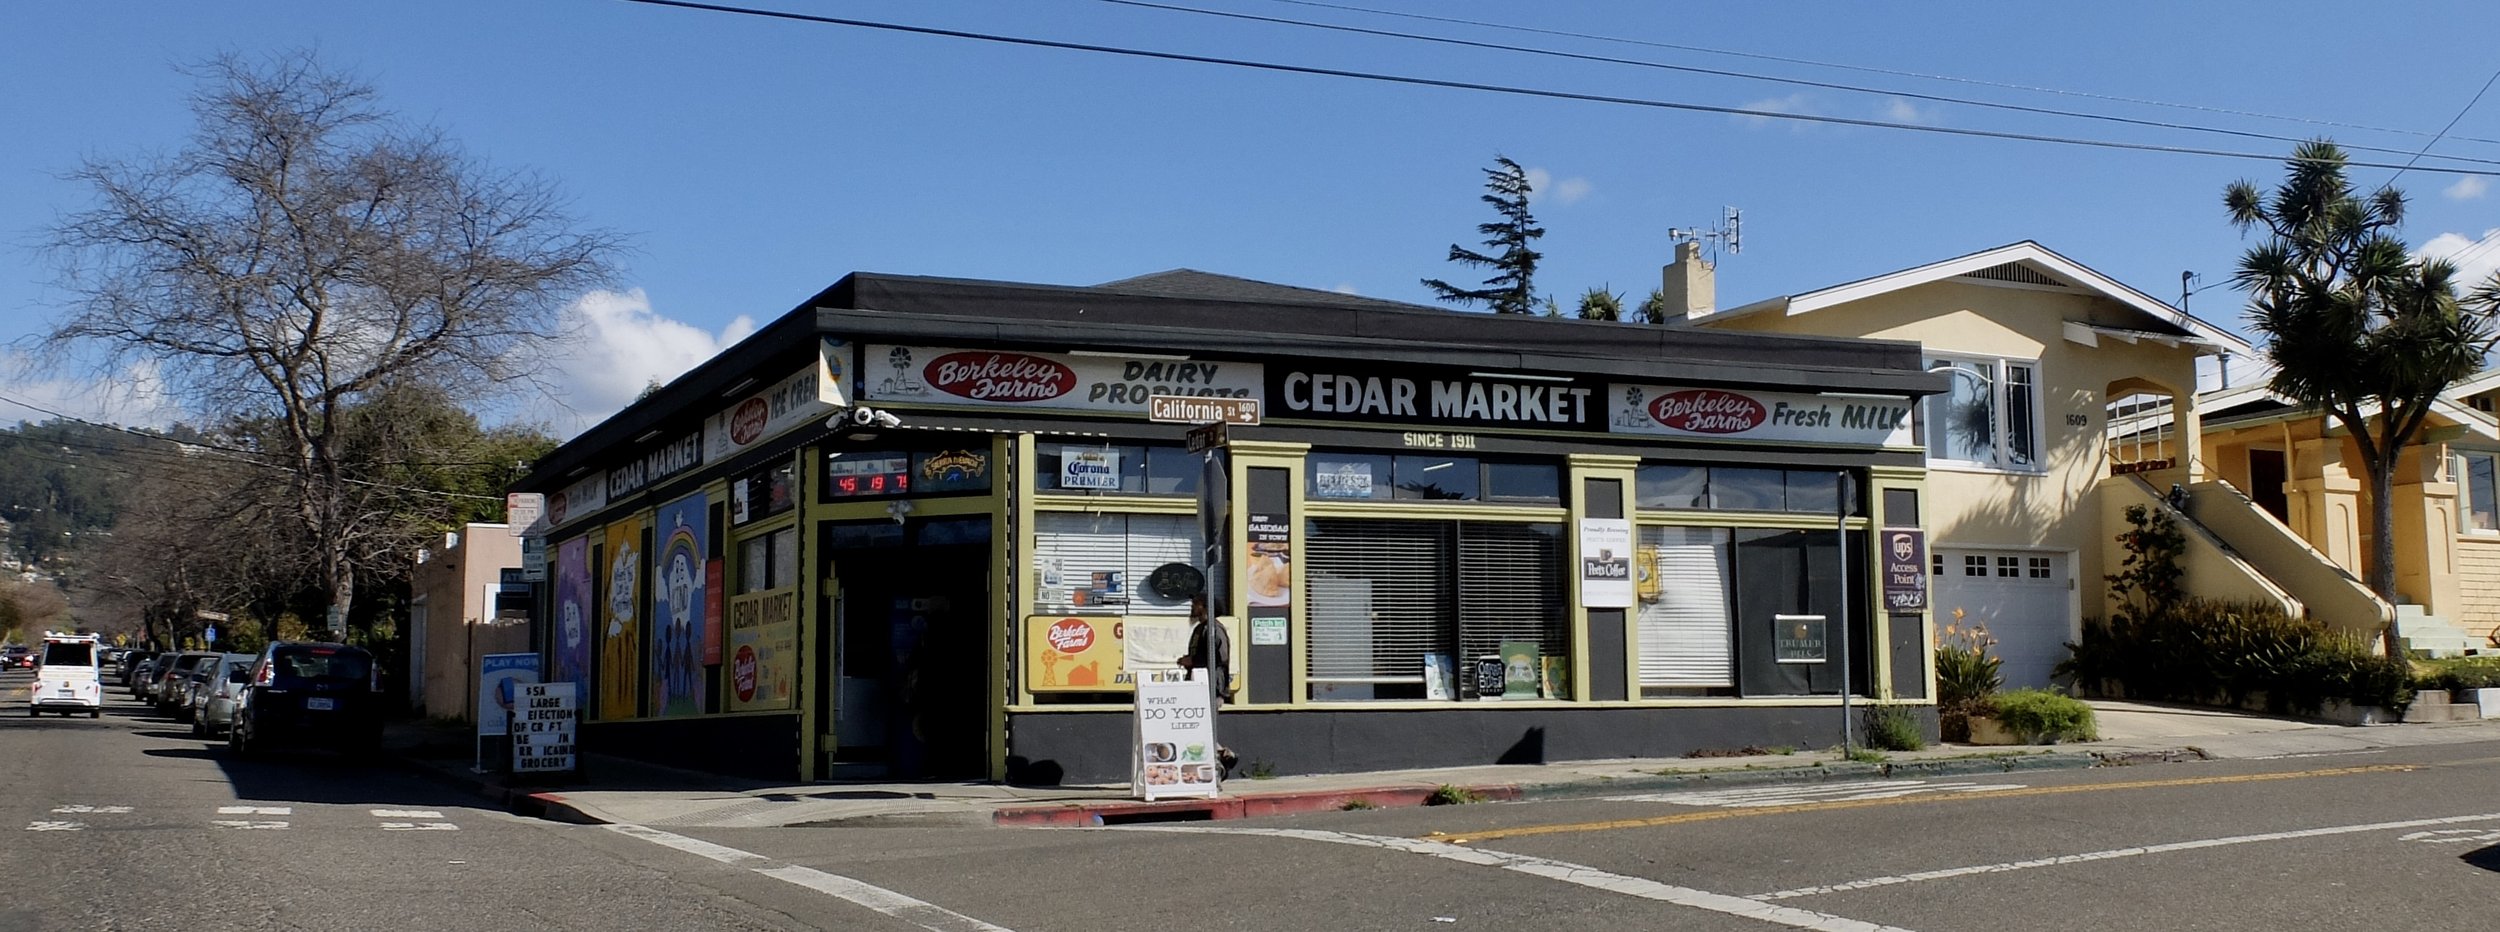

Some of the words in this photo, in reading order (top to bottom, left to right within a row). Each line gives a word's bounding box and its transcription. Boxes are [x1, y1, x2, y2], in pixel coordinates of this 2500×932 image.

[938, 354, 1062, 386] Berkeley
[1123, 361, 1218, 384] DAIRY
[970, 378, 1058, 398] Farms
[1284, 371, 1417, 416] CEDAR
[1431, 380, 1591, 423] MARKET
[1154, 399, 1223, 420] California
[1227, 406, 1236, 417] St
[1238, 402, 1256, 413] 1600
[1658, 391, 1755, 420] Berkeley
[1685, 412, 1751, 431] Farms
[1772, 402, 1831, 427] Fresh
[1841, 404, 1908, 431] MILK
[2066, 414, 2088, 427] 1609
[1403, 432, 1444, 447] SINCE
[1451, 434, 1476, 449] 1911
[610, 459, 644, 499] CEDAR
[648, 432, 700, 482] MARKET
[1068, 461, 1110, 477] Corona
[839, 477, 856, 491] 45
[871, 475, 885, 490] 19
[1064, 476, 1117, 487] PREMIER
[1895, 542, 1912, 558] ups
[1606, 563, 1627, 577] Coffee
[1890, 562, 1918, 573] Access
[1894, 574, 1915, 585] Point
[734, 599, 759, 630] CEDAR
[763, 592, 793, 625] MARKET
[1050, 625, 1090, 641] Berkeley
[530, 697, 560, 708] LARGE
[1145, 708, 1166, 720] DO
[1171, 707, 1205, 719] YOU
[514, 722, 527, 732] OF
[516, 734, 529, 744] BE
[521, 757, 567, 768] GROCERY
